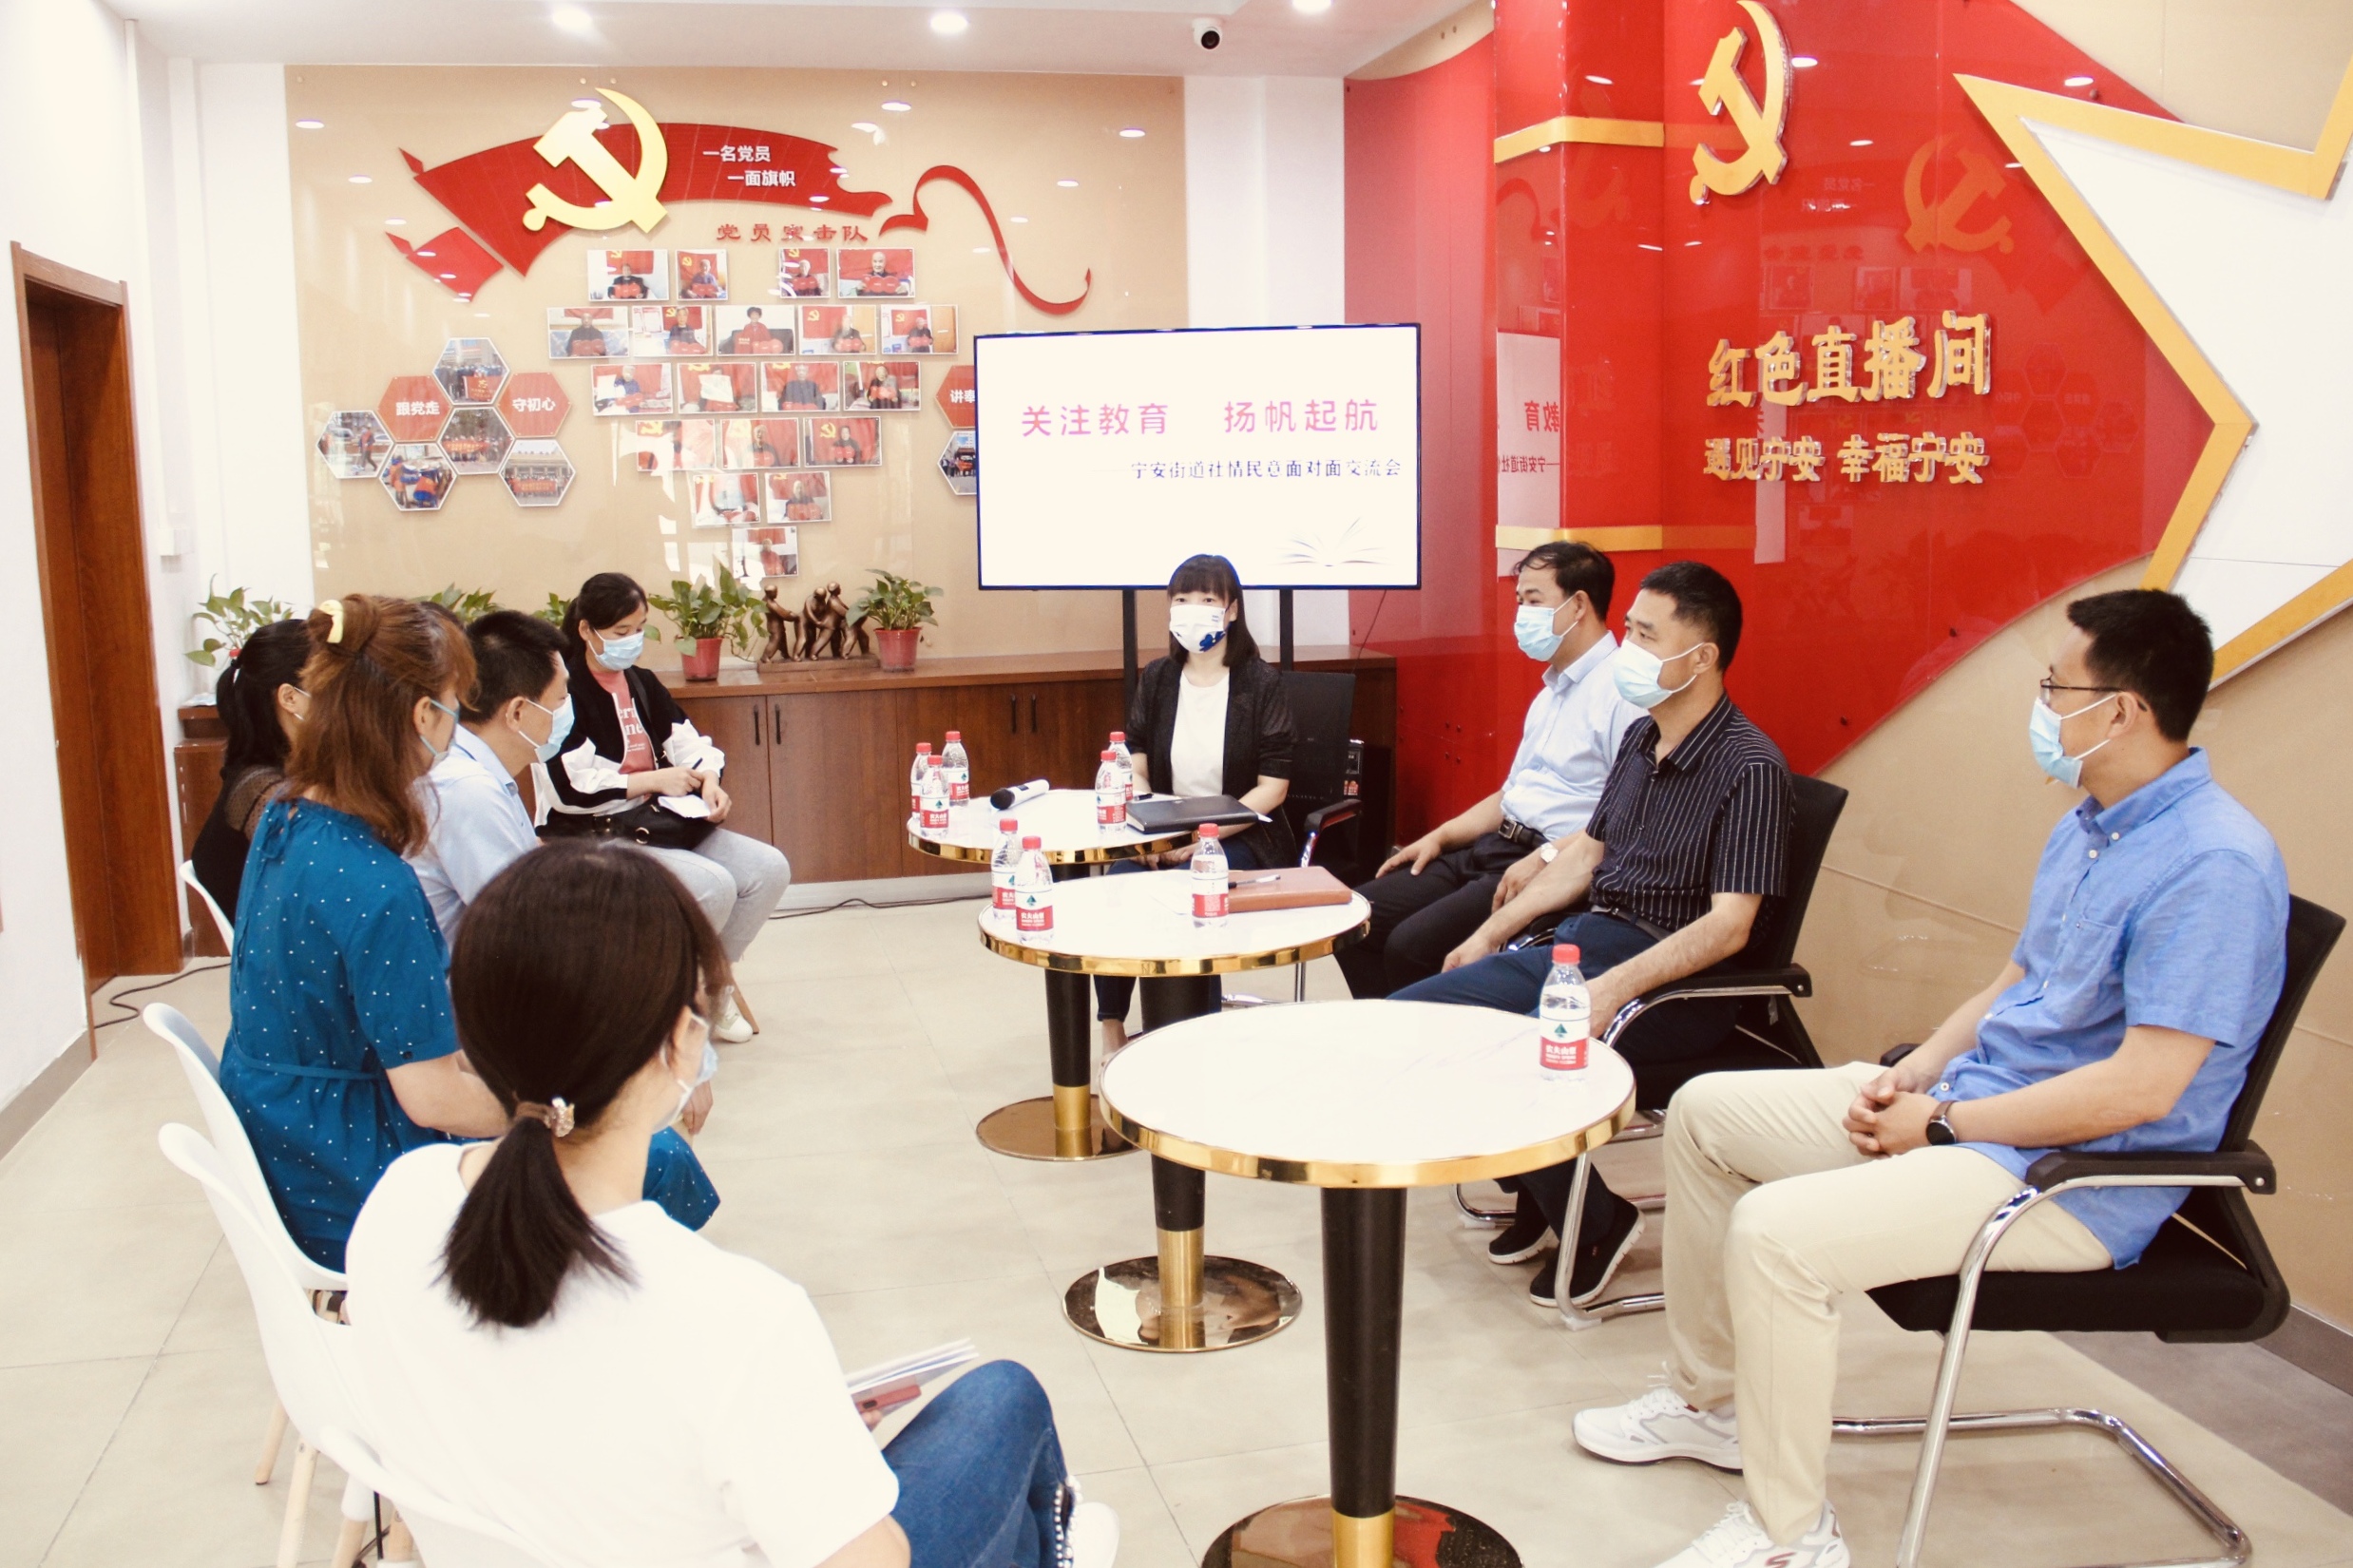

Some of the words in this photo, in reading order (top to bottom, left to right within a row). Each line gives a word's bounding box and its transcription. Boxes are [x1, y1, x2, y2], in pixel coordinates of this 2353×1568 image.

[702, 144, 771, 163] 一名党员
[727, 170, 796, 187] 一面旗帜
[716, 223, 869, 242] 党员突击队
[1707, 310, 1991, 408] 红色直播间
[395, 401, 440, 416] 跟党走
[512, 397, 556, 412] 守初心
[1022, 403, 1168, 437] 关注教育
[1224, 398, 1378, 432] 扬帆起航
[1703, 435, 1826, 482] 遇见宁安
[1837, 431, 1990, 484] 幸福宁安
